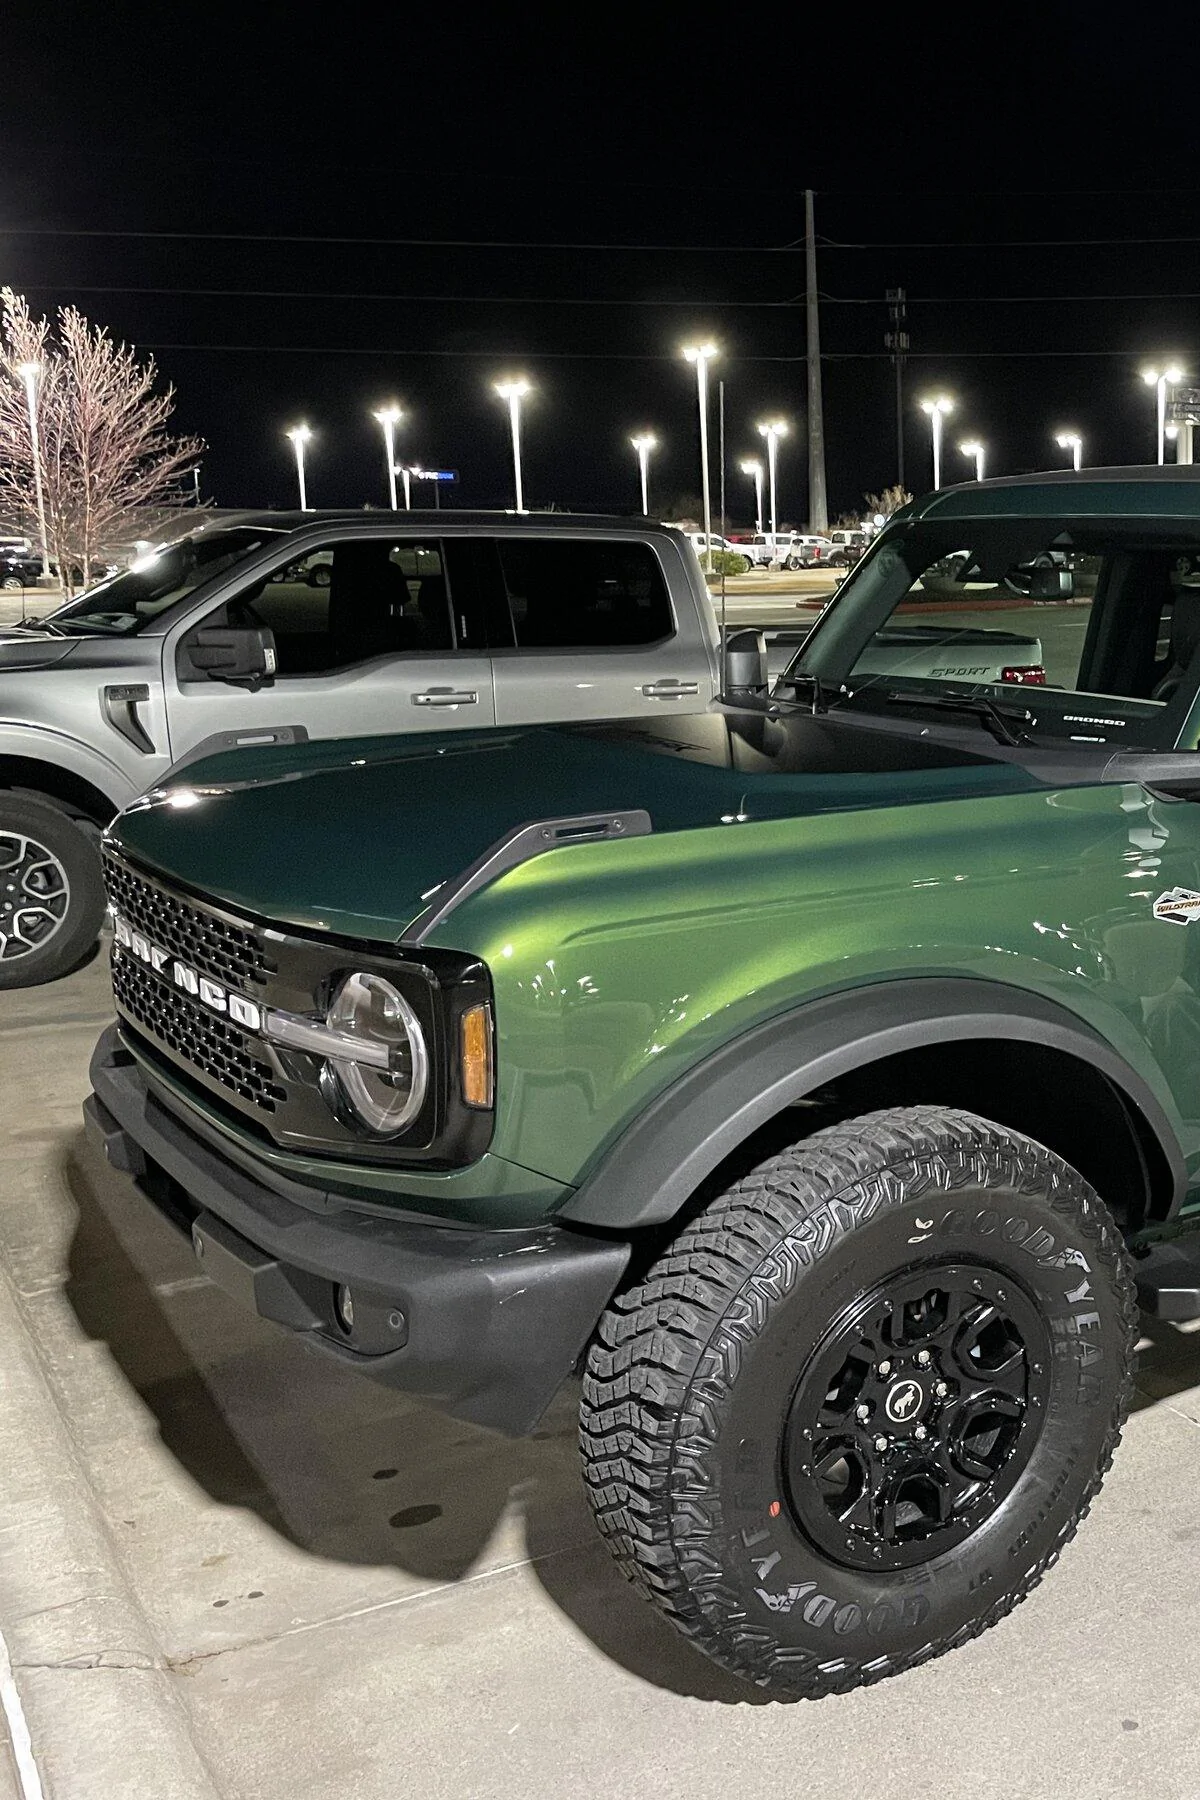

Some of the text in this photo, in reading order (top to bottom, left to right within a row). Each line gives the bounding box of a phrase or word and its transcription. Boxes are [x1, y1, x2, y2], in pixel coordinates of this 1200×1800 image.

[927, 667, 990, 678] SPORT
[1063, 715, 1126, 727] BRONCO
[939, 1208, 1106, 1406] GOODYEAR
